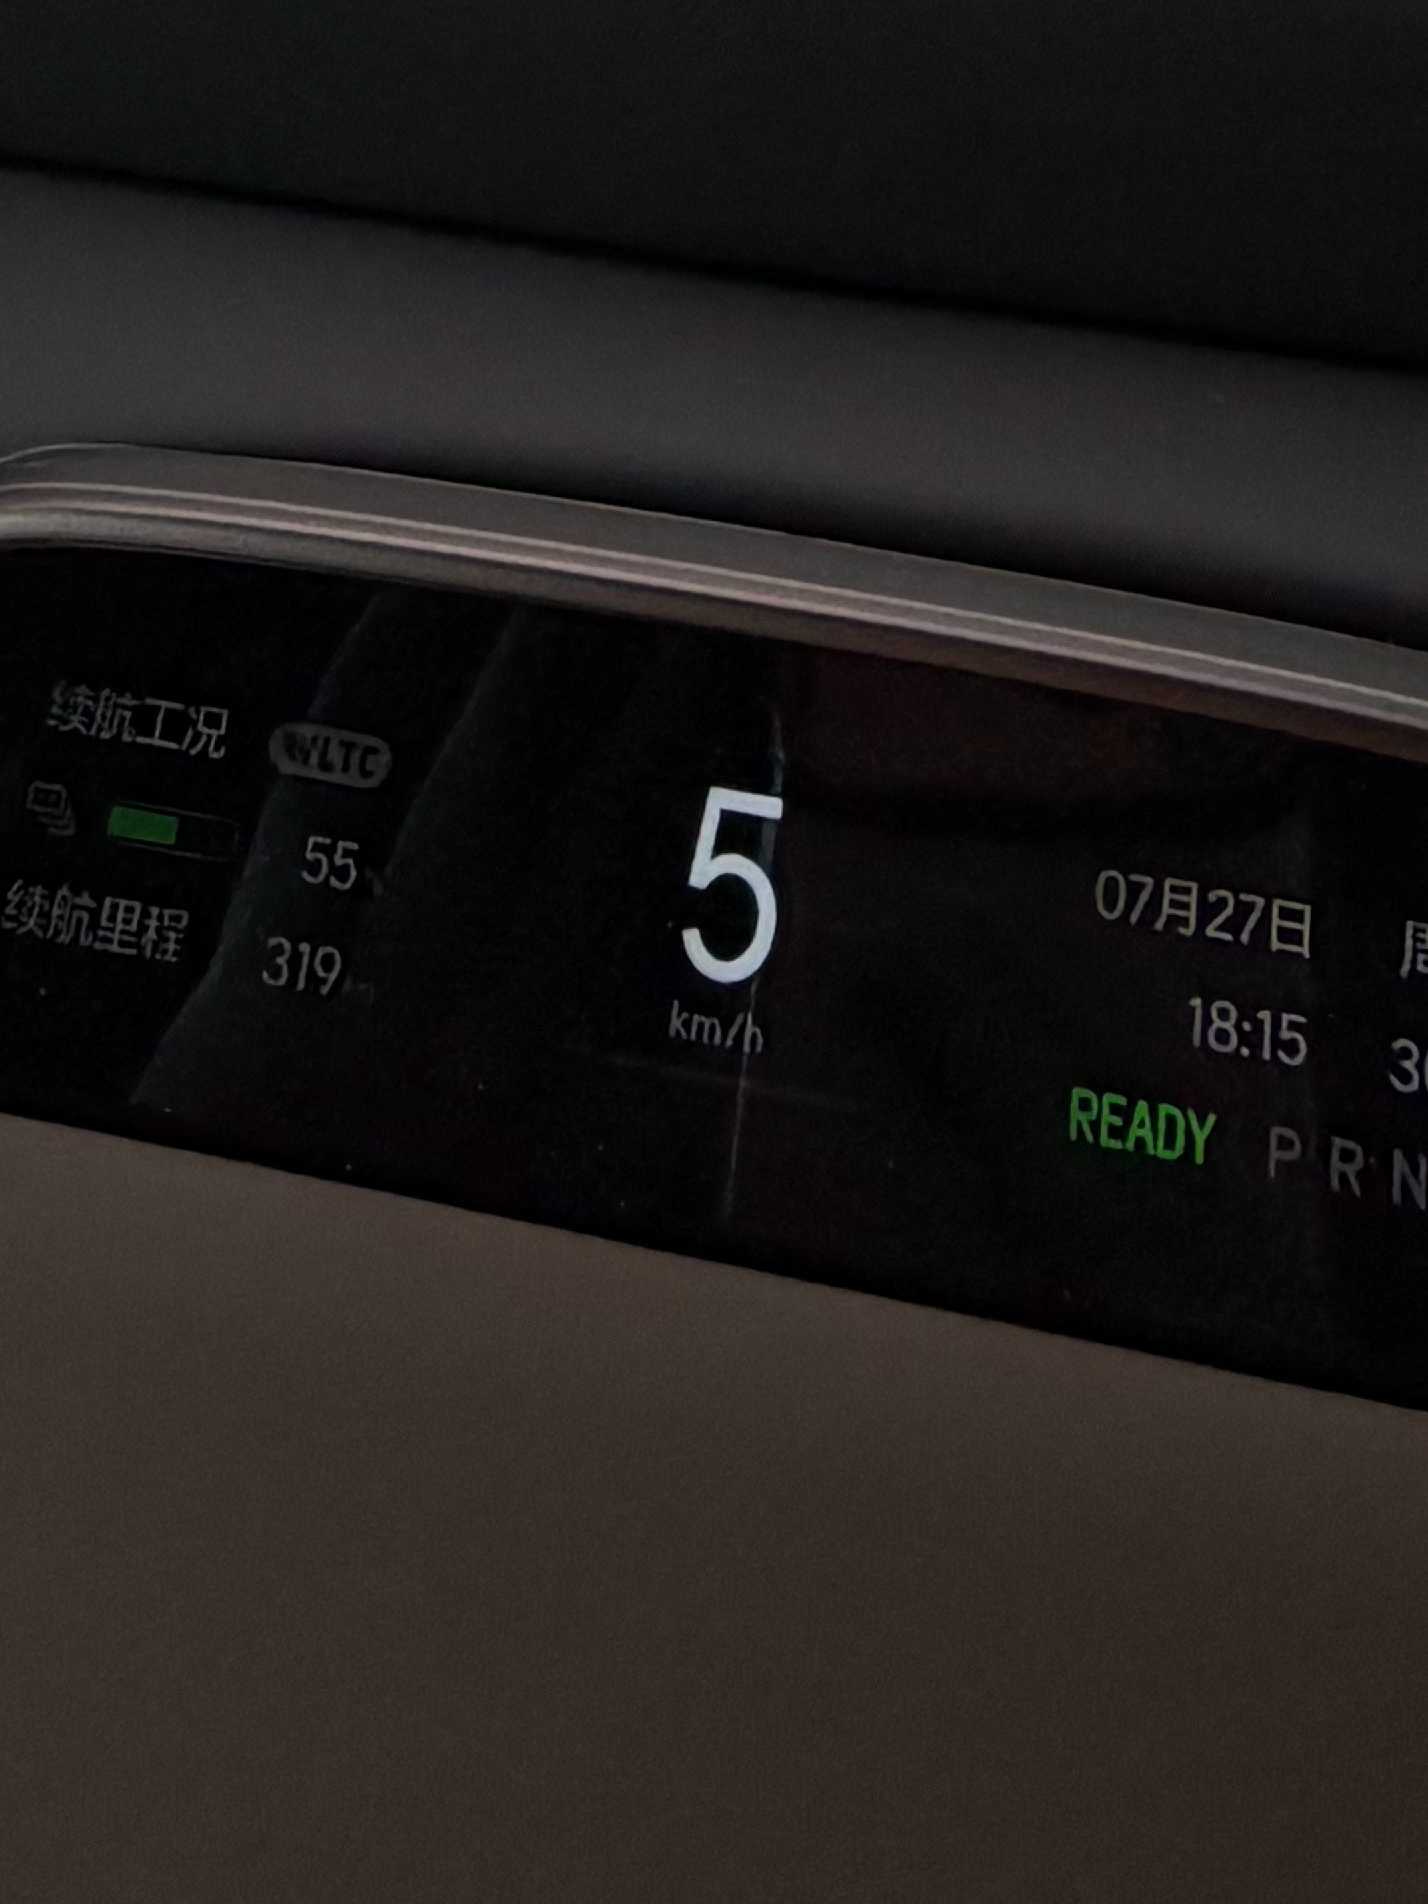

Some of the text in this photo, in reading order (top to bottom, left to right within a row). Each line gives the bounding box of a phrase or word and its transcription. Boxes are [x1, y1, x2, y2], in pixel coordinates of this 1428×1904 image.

[47, 679, 229, 761] 续航工况
[300, 835, 359, 892] 55
[682, 786, 784, 984] 5
[0, 878, 343, 996] 续航里程 319
[1095, 869, 1312, 960] 07月27日
[667, 999, 765, 1055] km/h
[1188, 995, 1308, 1067] 18:15
[1069, 1086, 1217, 1165] READY
[1269, 1125, 1301, 1179] P
[1329, 1135, 1363, 1197] R
[1391, 1148, 1428, 1211] N
